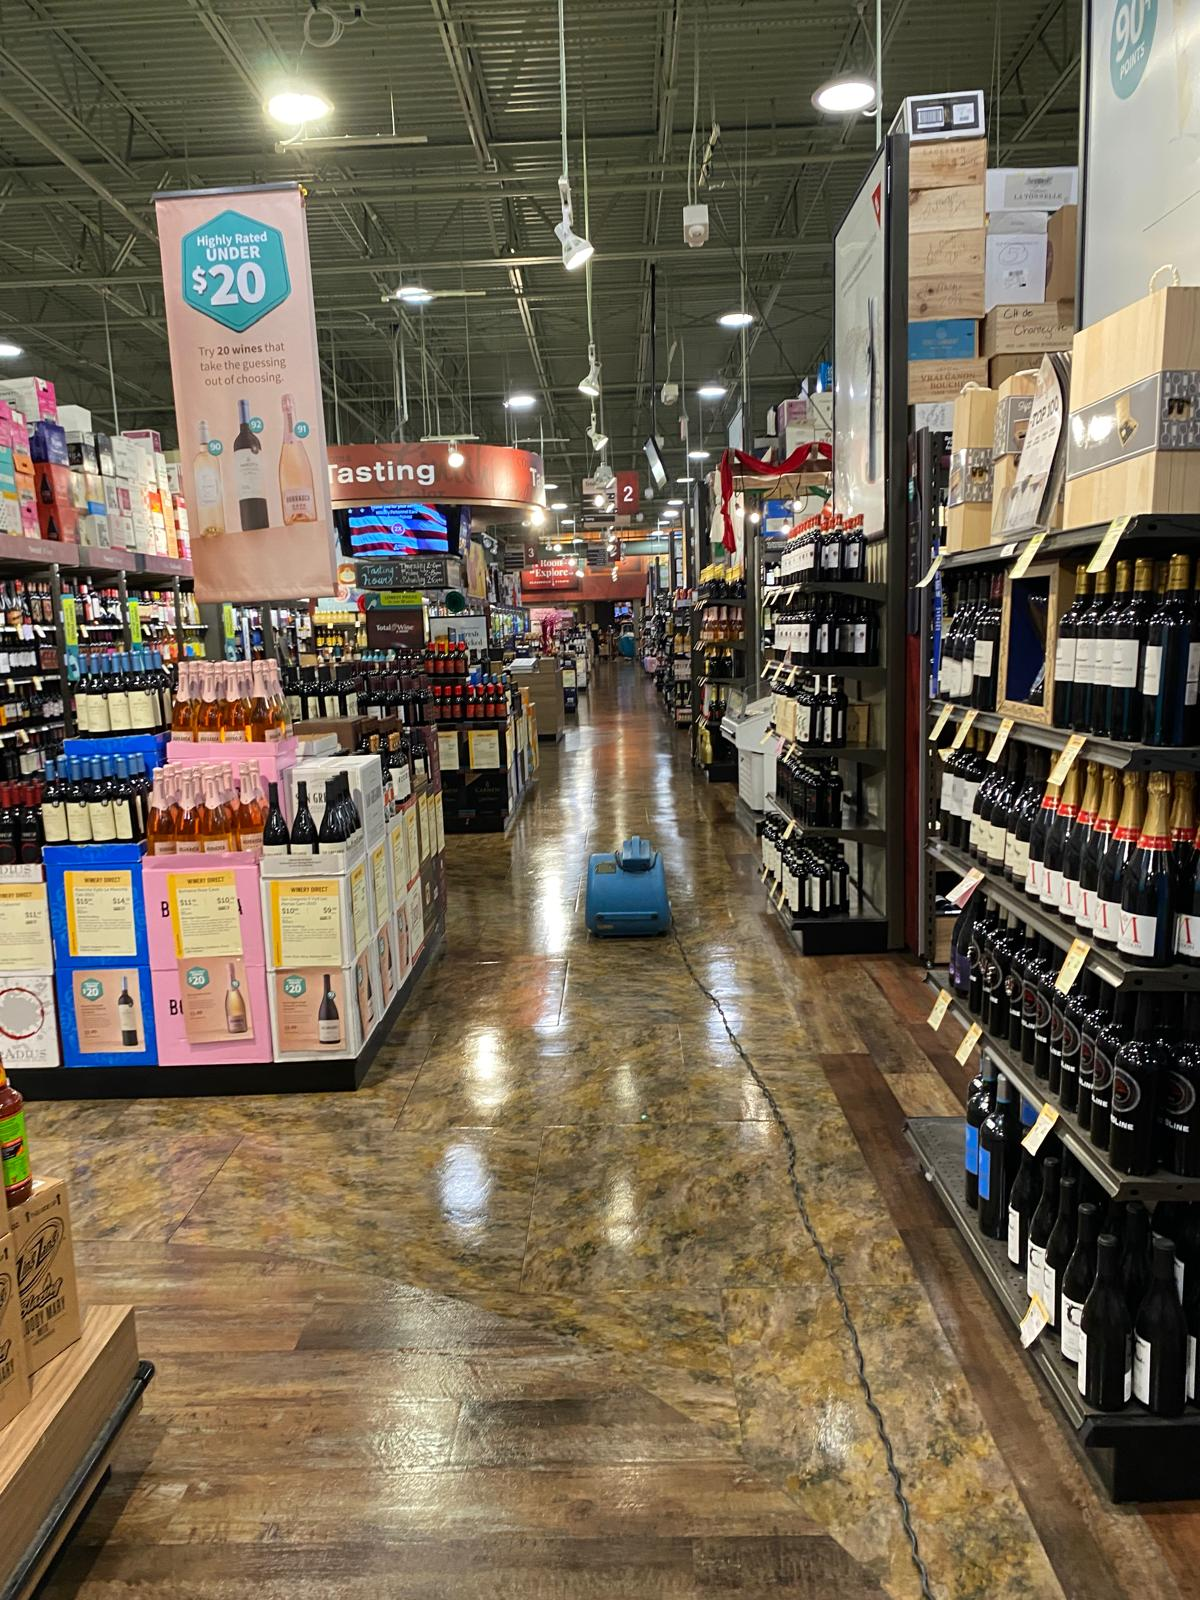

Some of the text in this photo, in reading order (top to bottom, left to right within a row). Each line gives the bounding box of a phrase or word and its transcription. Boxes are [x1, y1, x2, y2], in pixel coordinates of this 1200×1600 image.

[1119, 41, 1146, 81] POINTS
[196, 231, 268, 248] Highly Rated
[206, 246, 260, 262] UNDER
[192, 261, 266, 306] $20
[199, 342, 284, 358] Try 20 wines that
[200, 357, 286, 372] take the guessing
[204, 372, 284, 386] out of choosing.
[298, 424, 307, 434] 91
[210, 443, 222, 452] 90
[328, 460, 435, 486] Tasting
[623, 486, 634, 502] 2
[528, 548, 535, 558] 3
[362, 564, 394, 575] Tasting
[536, 568, 568, 578] Explore
[376, 624, 392, 632] Total
